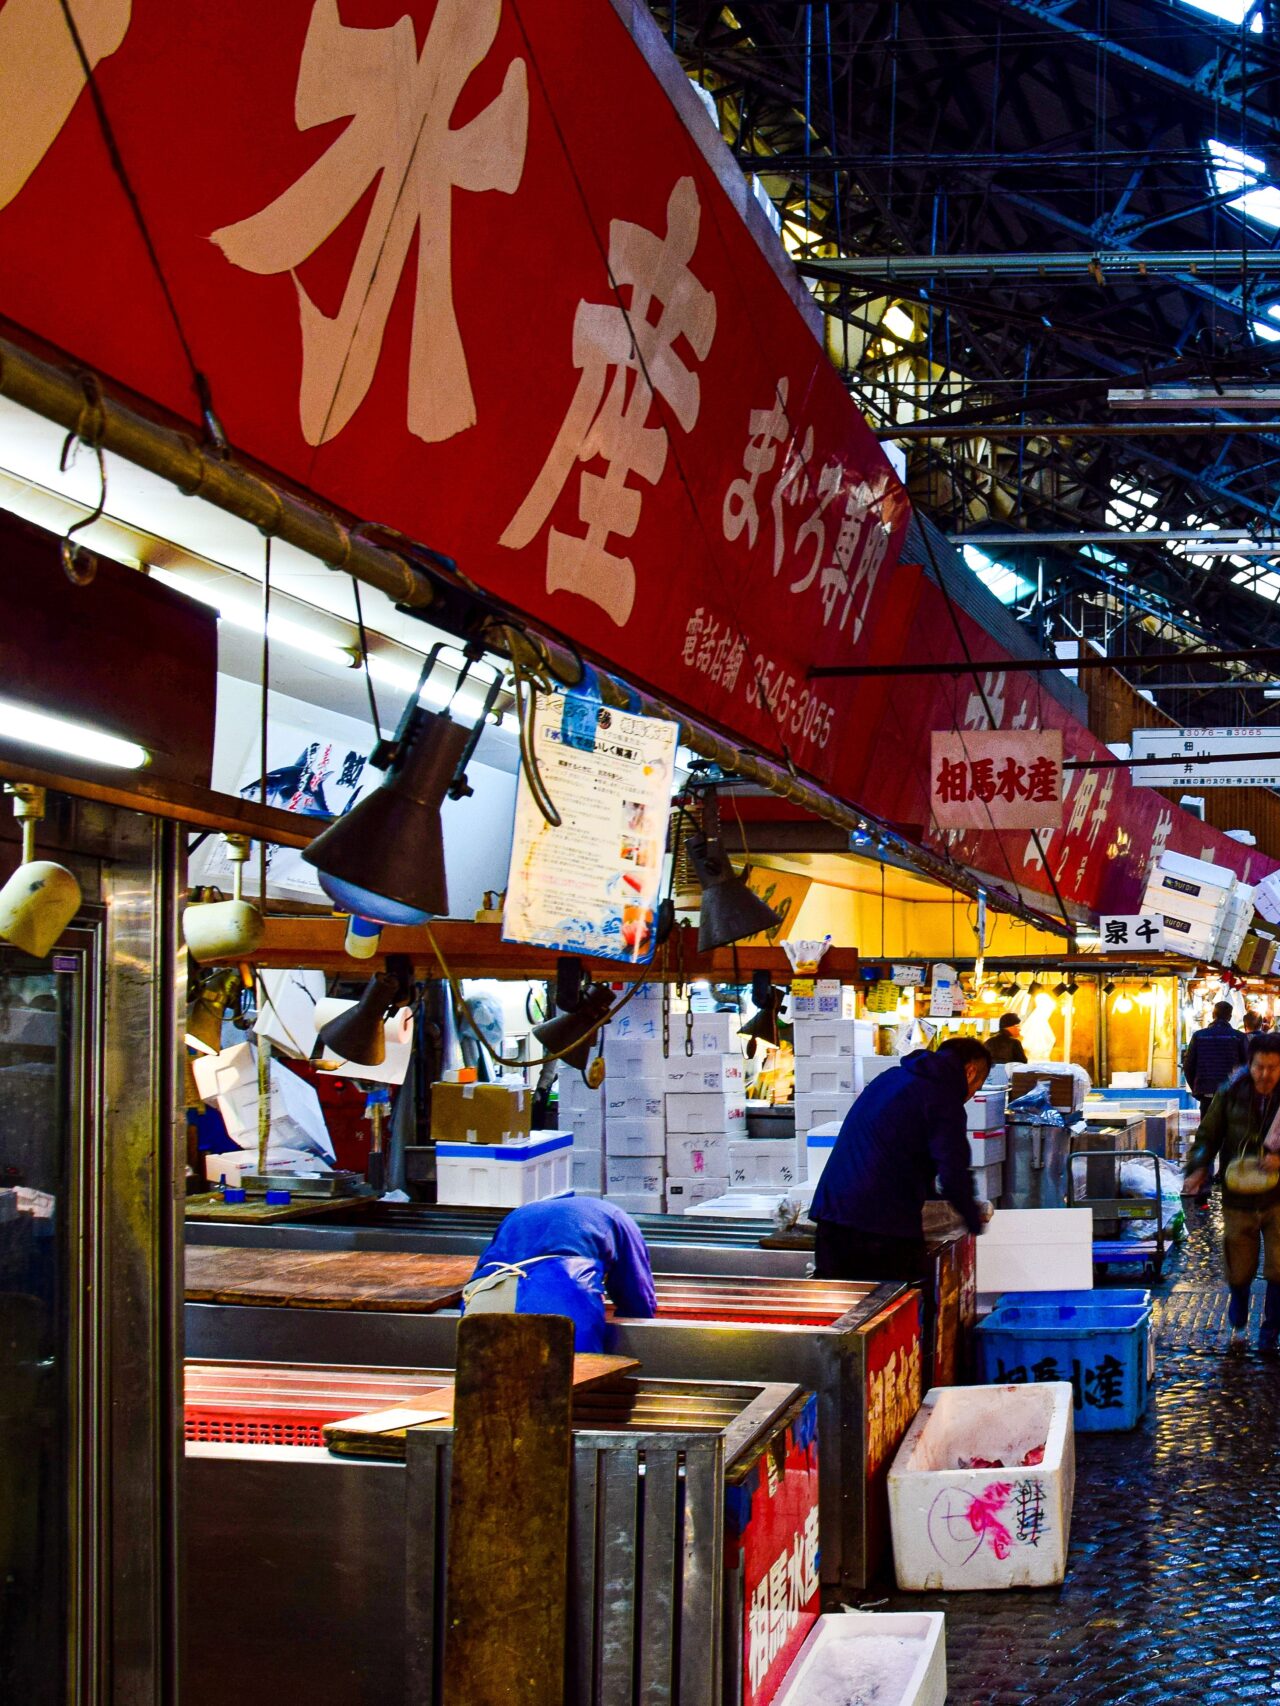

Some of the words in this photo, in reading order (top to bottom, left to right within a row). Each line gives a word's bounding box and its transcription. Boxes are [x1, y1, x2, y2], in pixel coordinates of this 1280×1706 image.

[722, 376, 892, 645] まぐろ専門
[681, 607, 749, 693] 電話店舗
[936, 756, 1060, 804] 相馬水産
[749, 1504, 819, 1698] 相馬水産
